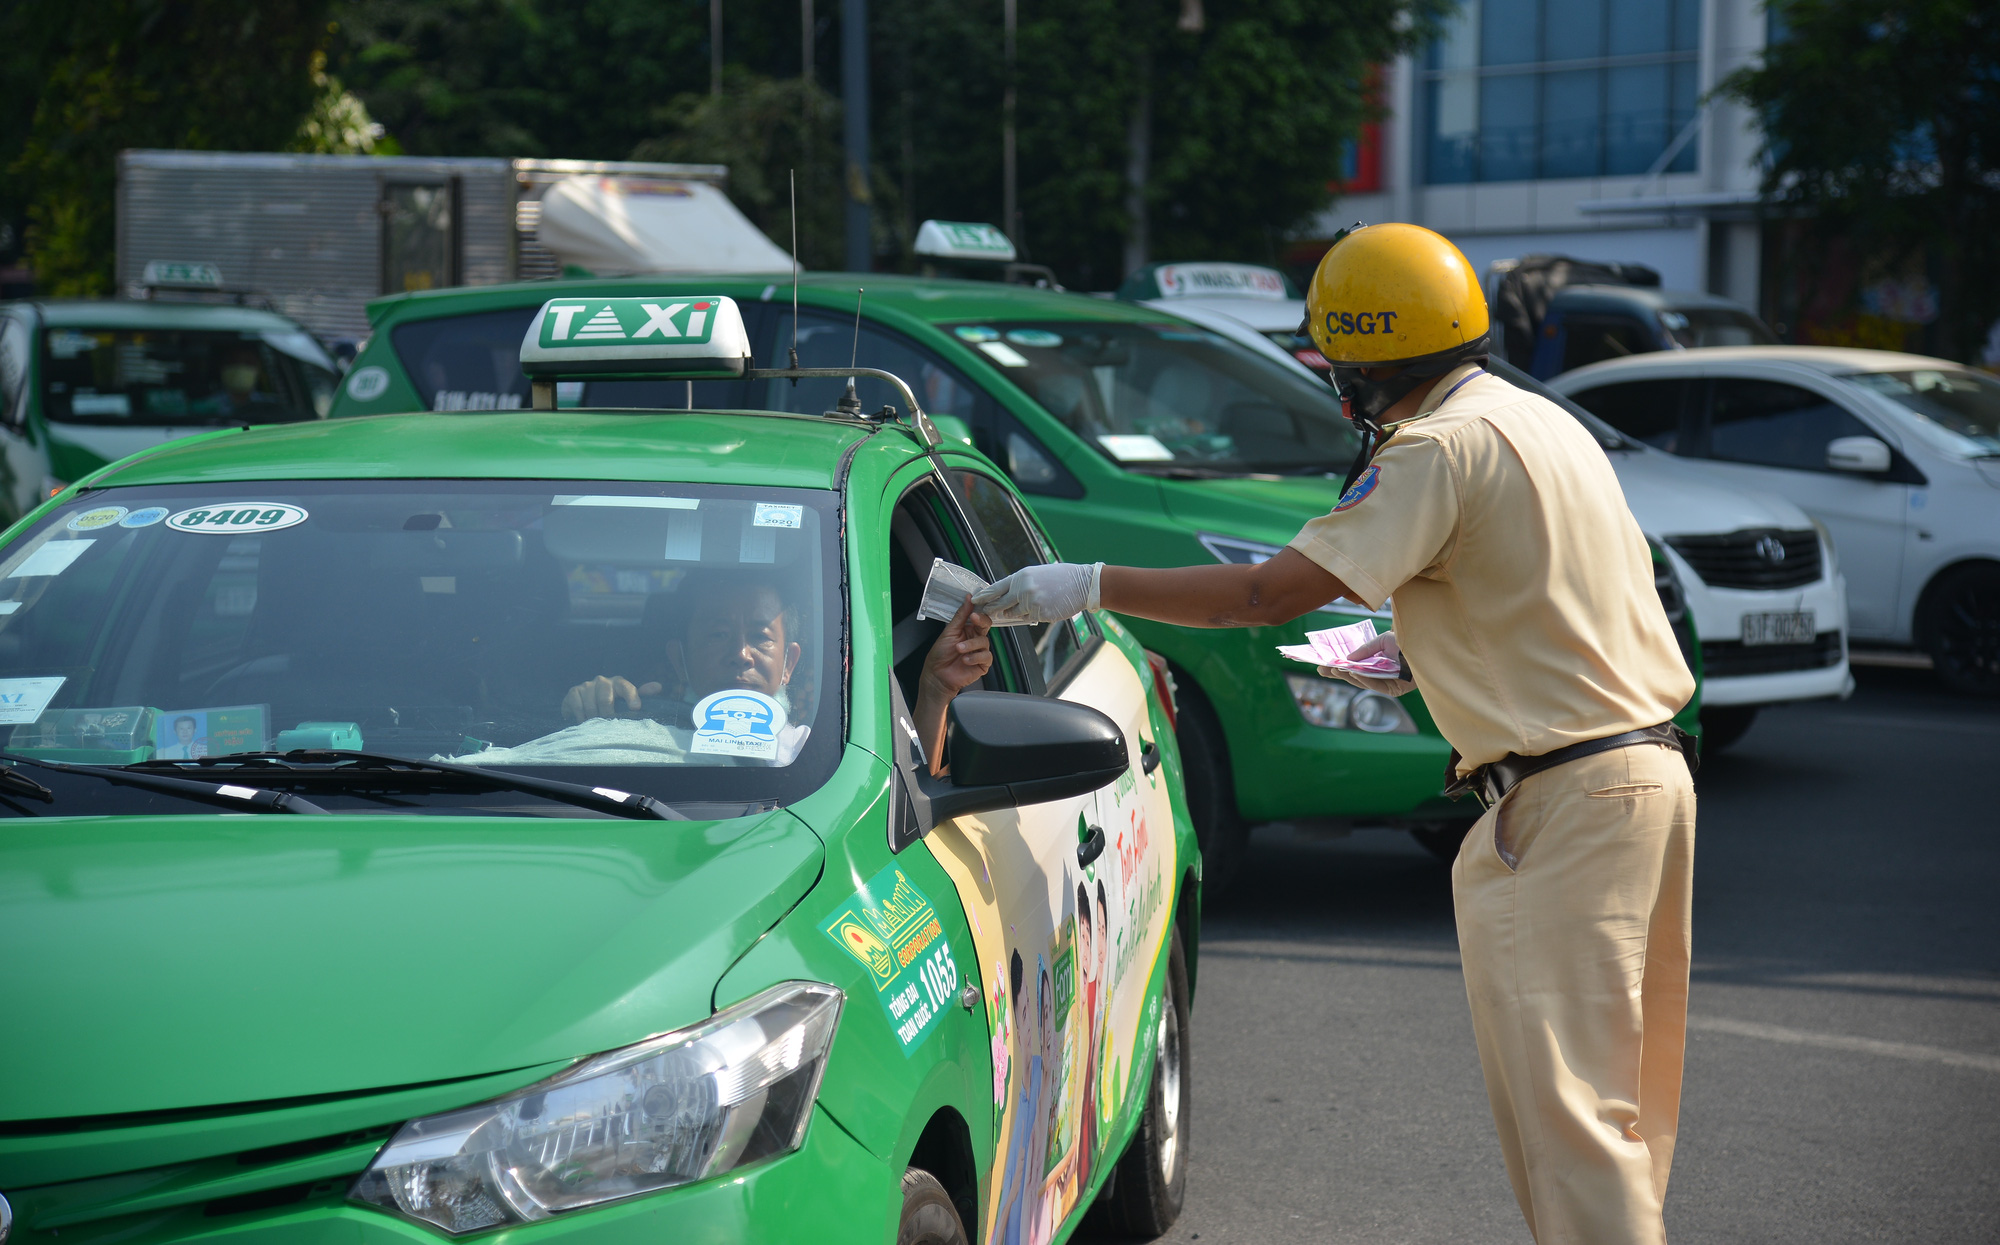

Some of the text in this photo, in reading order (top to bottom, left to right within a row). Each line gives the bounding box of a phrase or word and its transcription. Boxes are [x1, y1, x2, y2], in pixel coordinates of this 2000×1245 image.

[1325, 311, 1398, 335] CSGT
[180, 509, 287, 526] 8409
[897, 917, 943, 969] CORPORATION
[919, 940, 957, 1014] 1055
[904, 981, 920, 1005] ĐÀI
[897, 1018, 919, 1046] TOÀN
